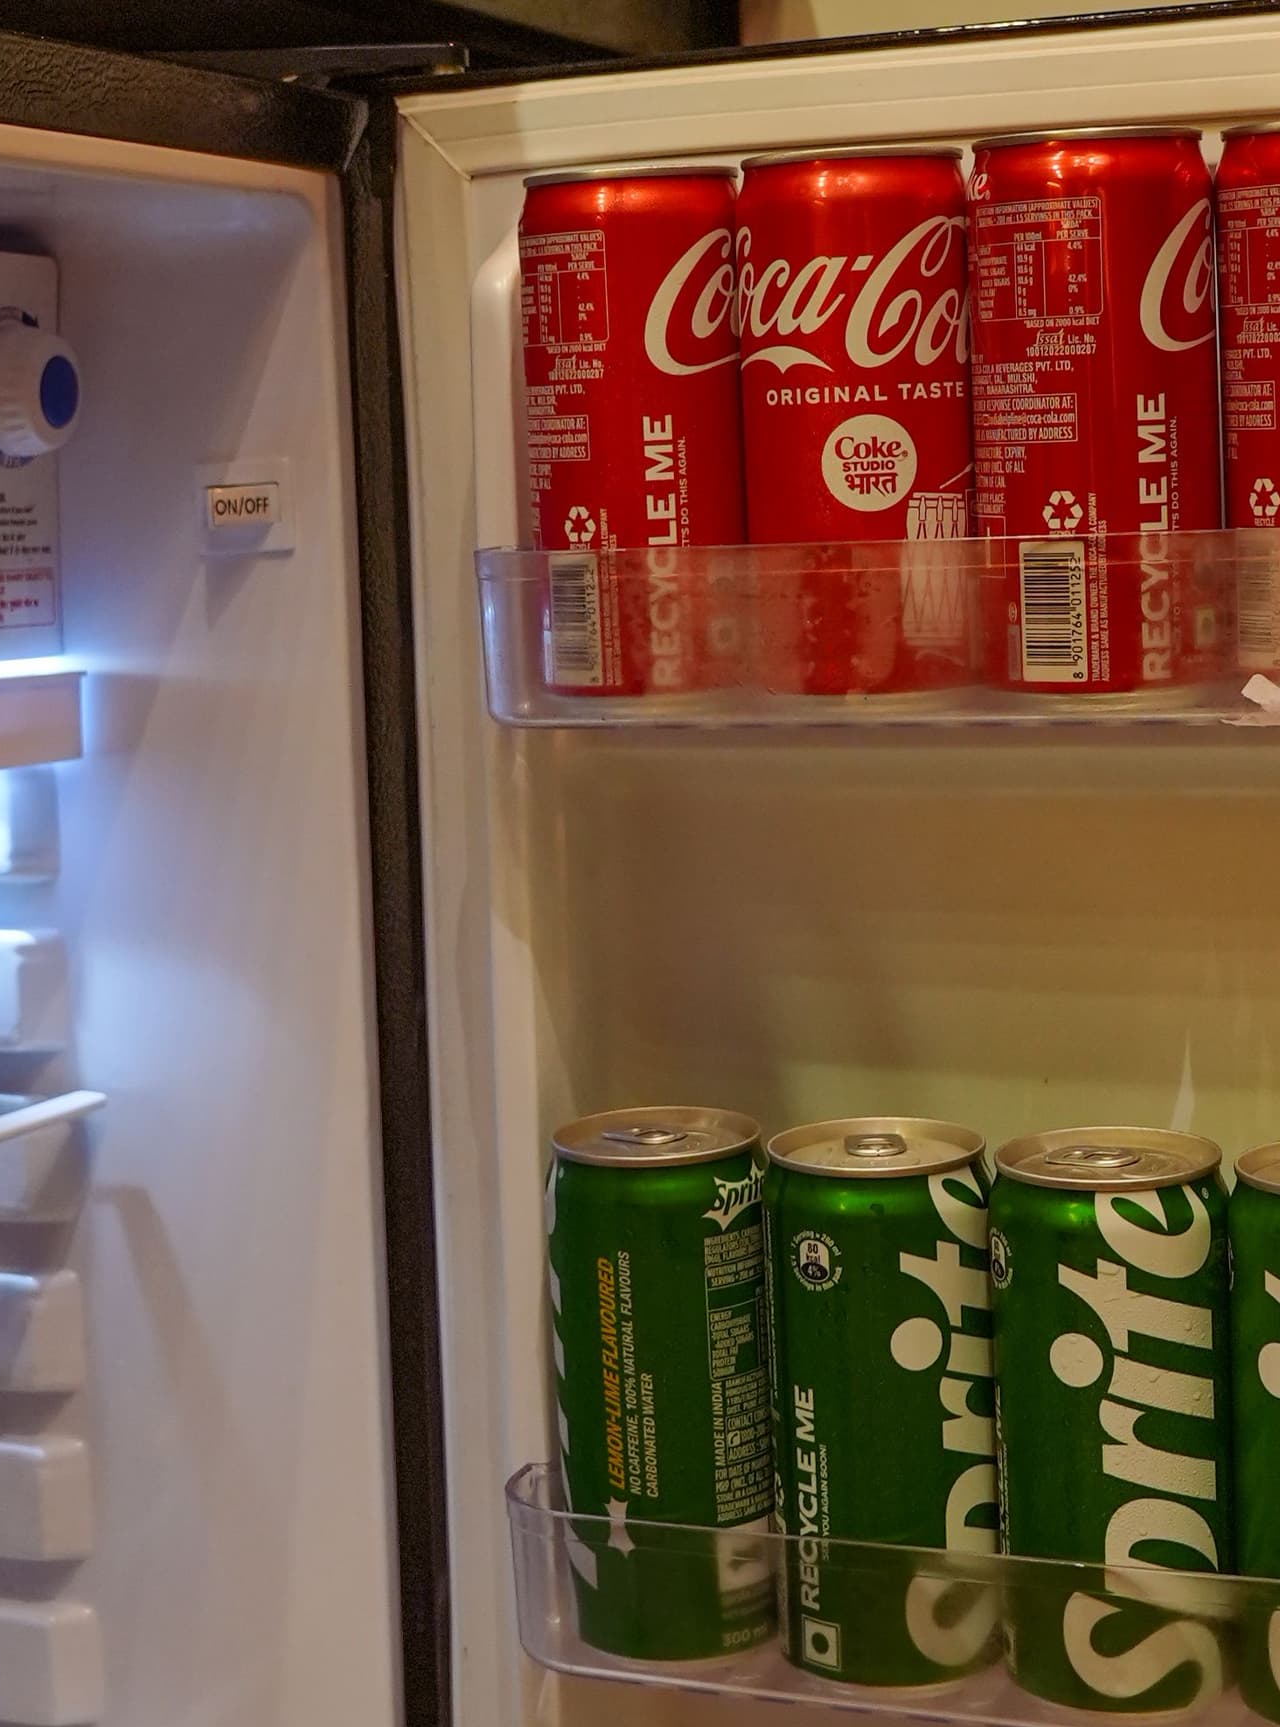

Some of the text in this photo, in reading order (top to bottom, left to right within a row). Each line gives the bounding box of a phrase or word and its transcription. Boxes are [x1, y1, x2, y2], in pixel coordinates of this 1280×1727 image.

[1067, 333, 1097, 345] Lic. No.
[1035, 361, 1054, 372] PVT.
[766, 385, 888, 406] ORIGINAL
[898, 381, 964, 400] TASTE
[1012, 397, 1061, 410] COORDINATOR
[1061, 396, 1074, 410] AT:
[834, 436, 903, 460] Coke
[1028, 428, 1038, 441] BY
[1039, 426, 1073, 439] ADDRESS
[842, 460, 896, 472] STUDIO
[1005, 460, 1025, 473] OF ALL
[1170, 416, 1179, 509] DO THIS AGAIN.
[678, 436, 690, 525] DO THIS AGAIN.
[844, 472, 898, 497] भारत
[215, 496, 269, 517] ON/OFF
[1087, 492, 1096, 526] COMPANY
[642, 414, 682, 687] RECYCLE ME
[1137, 392, 1171, 680] RECYCLE ME
[1071, 556, 1084, 680] 8 901764 011252
[807, 1243, 819, 1254] 80
[618, 1251, 633, 1316] FLAVOURS
[621, 1320, 636, 1376] NATURAL
[597, 1257, 625, 1489] LEMON-LIME FLAVOURED
[625, 1377, 637, 1410] 100%
[640, 1373, 659, 1498] CARBONATED WATER
[711, 1382, 726, 1466] MADE IN INDIA
[1048, 1183, 1223, 1718] Sprite
[630, 1476, 642, 1495] NO
[794, 1384, 820, 1611] RECYCLE ME
[819, 1444, 831, 1537] YOU AGAIN SOON!
